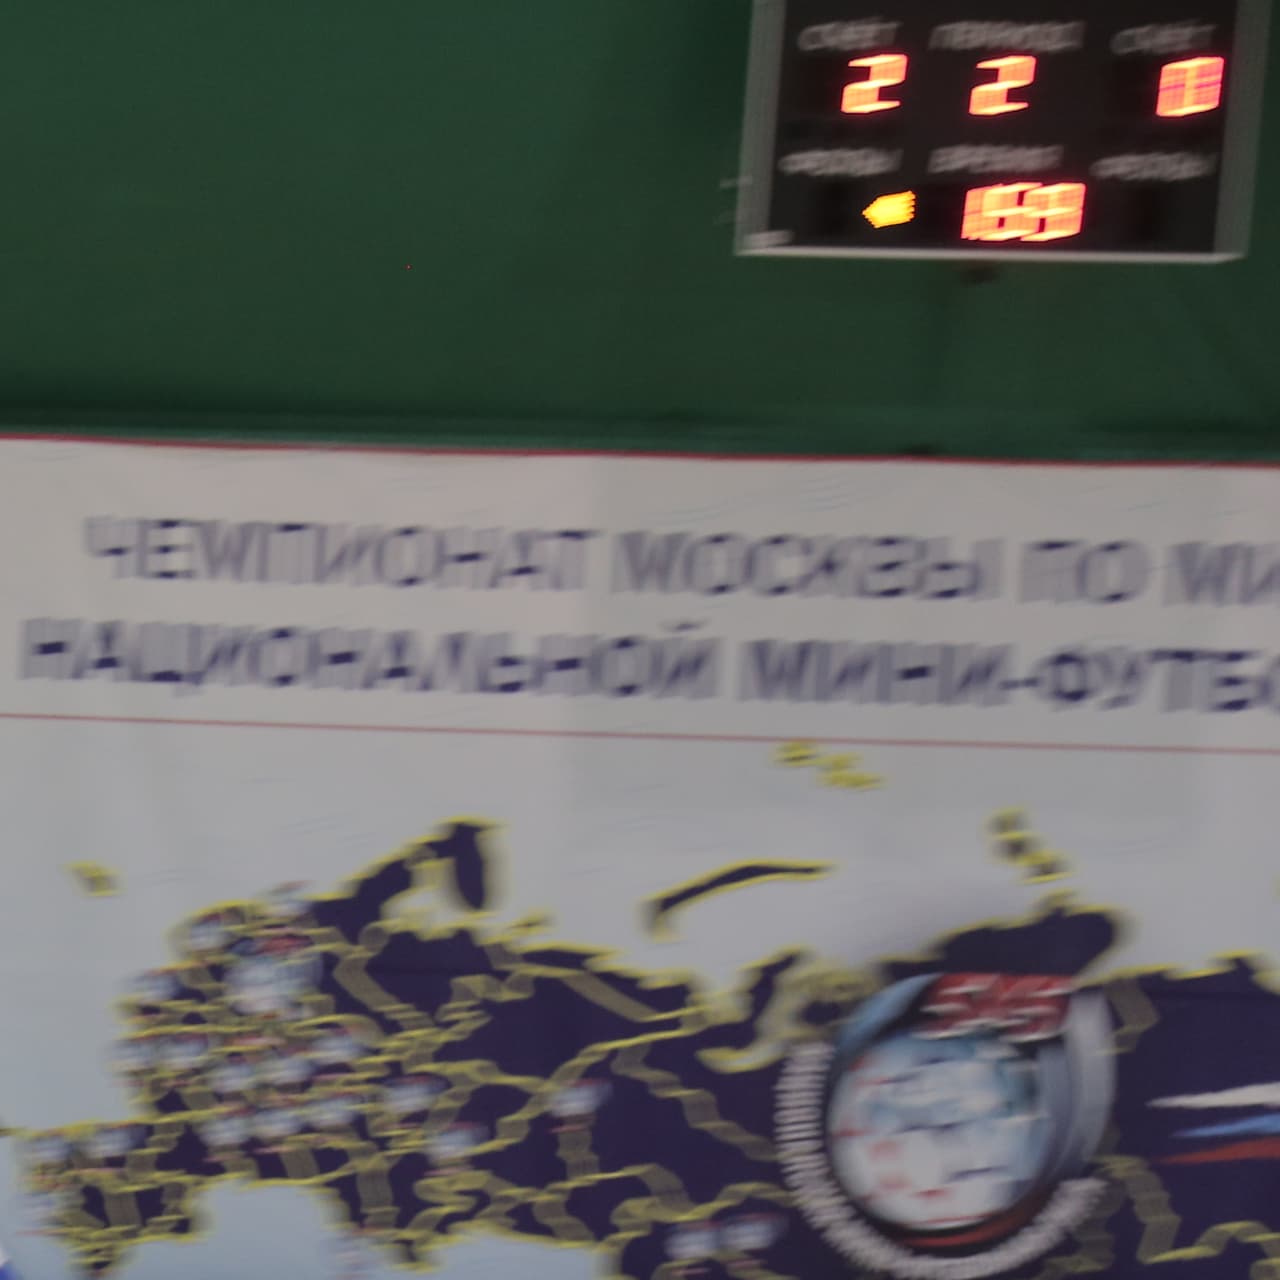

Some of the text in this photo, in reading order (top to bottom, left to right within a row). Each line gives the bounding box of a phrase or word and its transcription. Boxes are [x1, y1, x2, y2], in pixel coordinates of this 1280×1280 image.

[841, 54, 908, 114] 2
[968, 55, 1037, 116] 2
[83, 516, 598, 591] ЧЕМПИОНАТ
[610, 530, 1006, 602] МОСКВЫ
[1017, 538, 1147, 602] ПО
[19, 616, 723, 699] НАЦИОНАЛЬНОЙ
